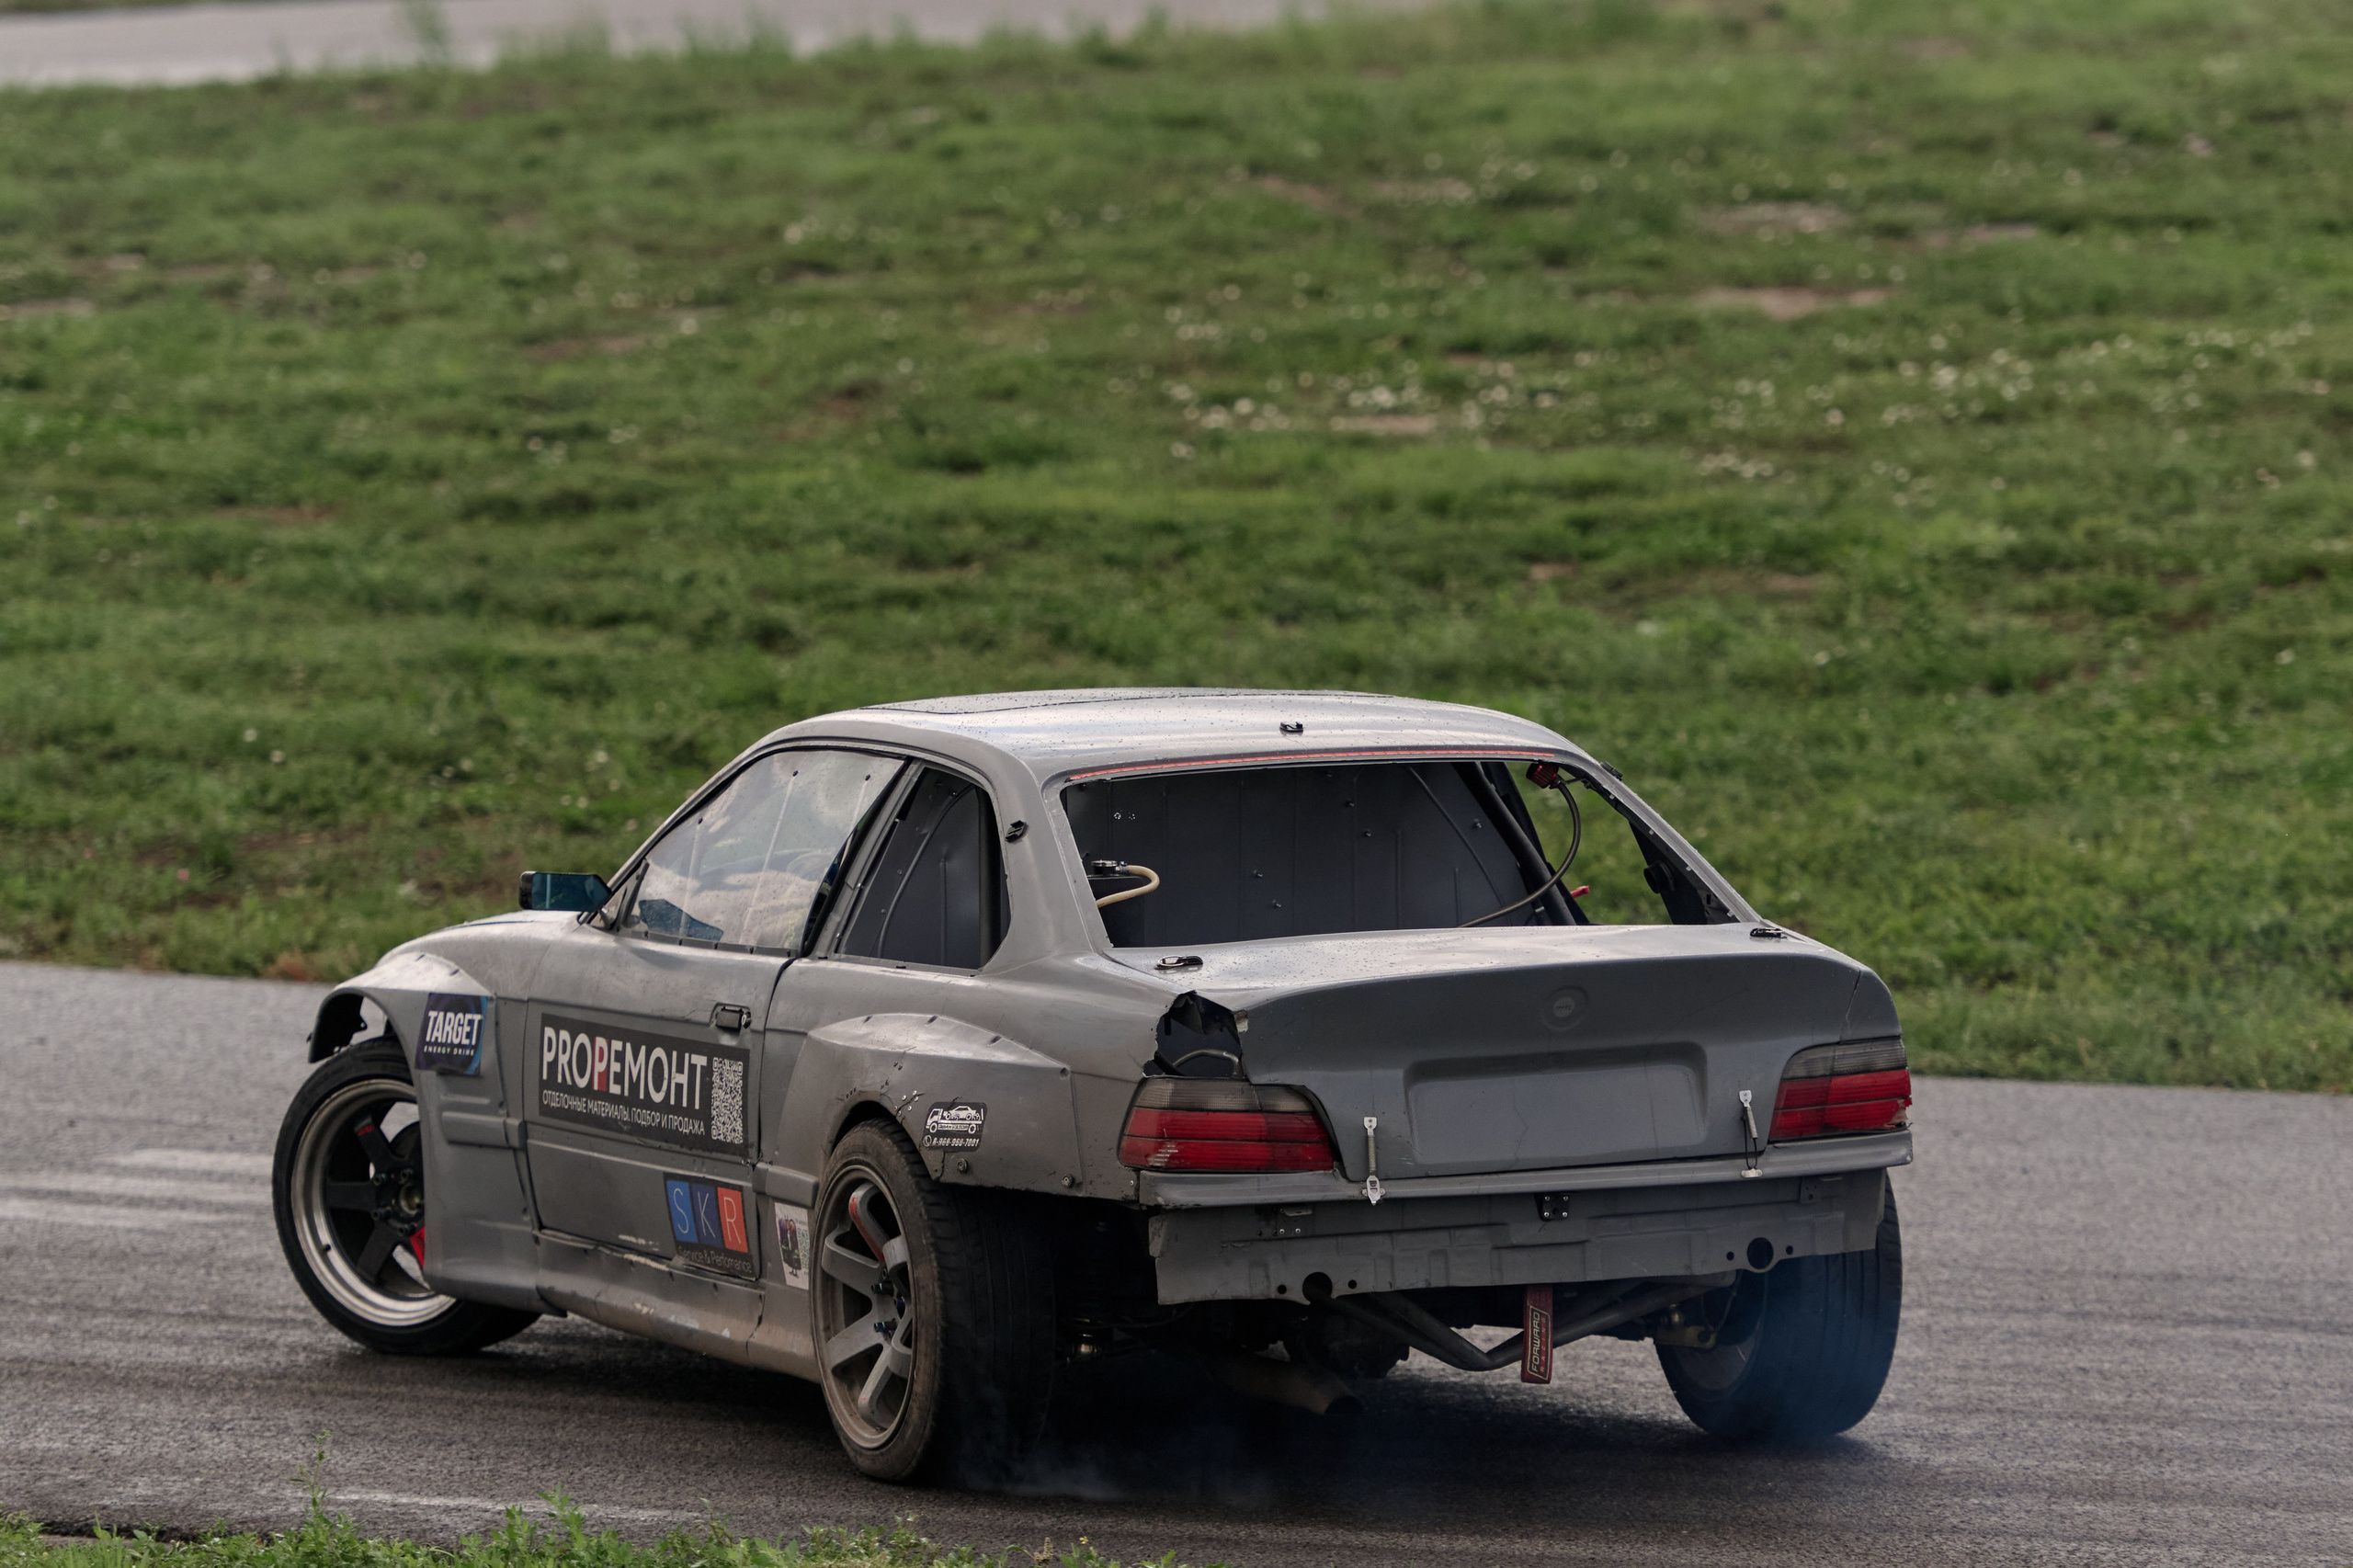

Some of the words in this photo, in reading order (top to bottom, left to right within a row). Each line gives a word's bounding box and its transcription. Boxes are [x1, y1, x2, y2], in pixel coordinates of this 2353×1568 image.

[426, 1010, 483, 1045] TARGET
[424, 1045, 450, 1055] ENERGY
[453, 1048, 474, 1056] DRINK
[542, 1090, 586, 1113] ОТДЕЛОЧНЫЕ
[631, 1108, 661, 1127] ПОДБОР
[661, 1115, 667, 1129] И
[668, 1116, 705, 1136] ПРОДАЖА
[677, 1246, 704, 1263] Service
[1531, 1312, 1540, 1372] FORWARD
